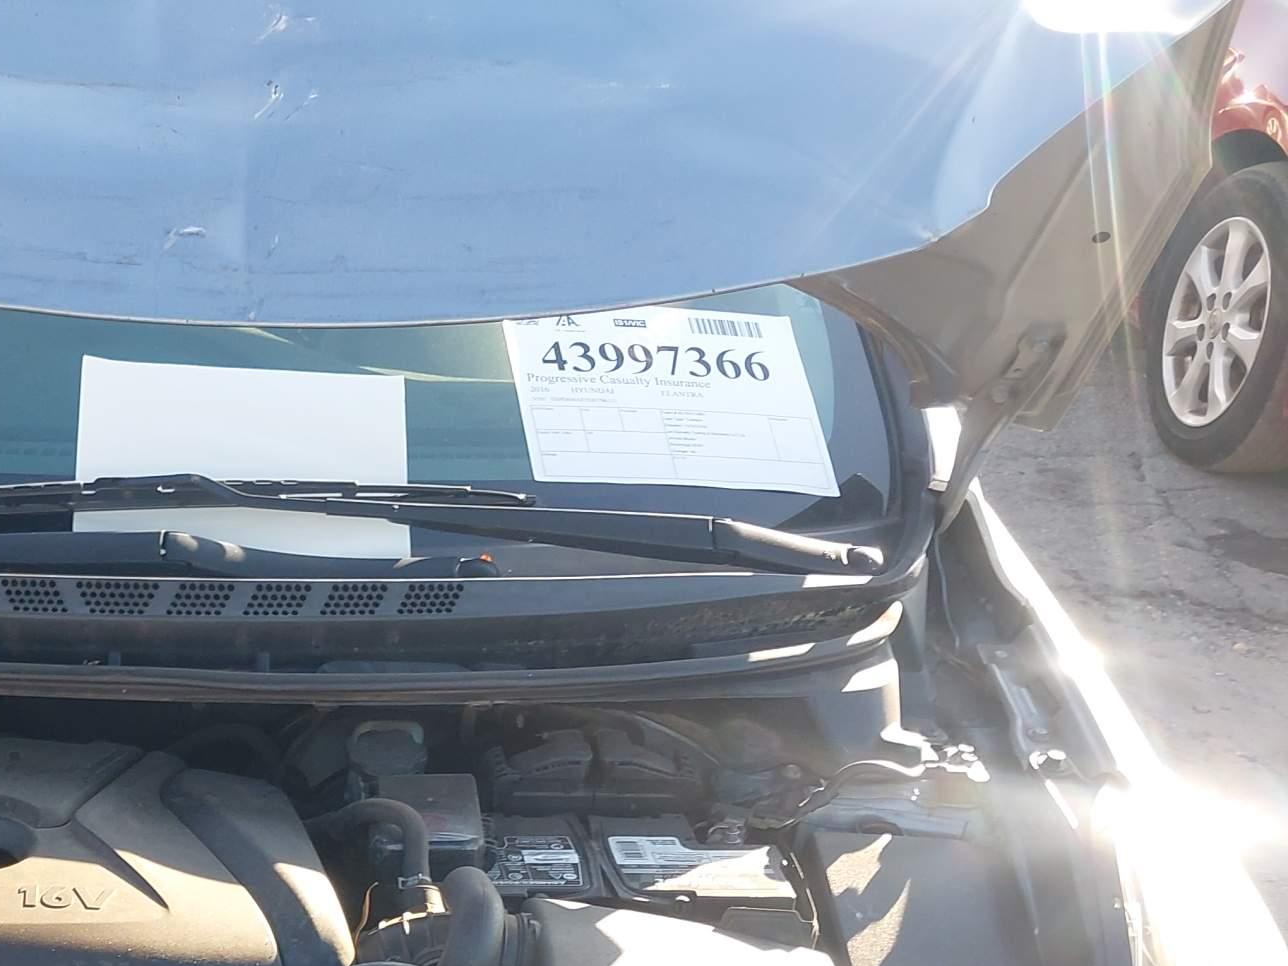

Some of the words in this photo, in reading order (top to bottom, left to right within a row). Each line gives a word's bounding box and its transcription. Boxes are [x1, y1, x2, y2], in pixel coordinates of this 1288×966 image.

[542, 340, 771, 382] 43997366
[527, 372, 596, 385] Progressive
[599, 374, 651, 388] Casualty
[655, 376, 711, 389] Insurance
[571, 386, 615, 395] HYUNDAI
[660, 389, 705, 399] ELANTRA
[17, 884, 112, 910] 16V
